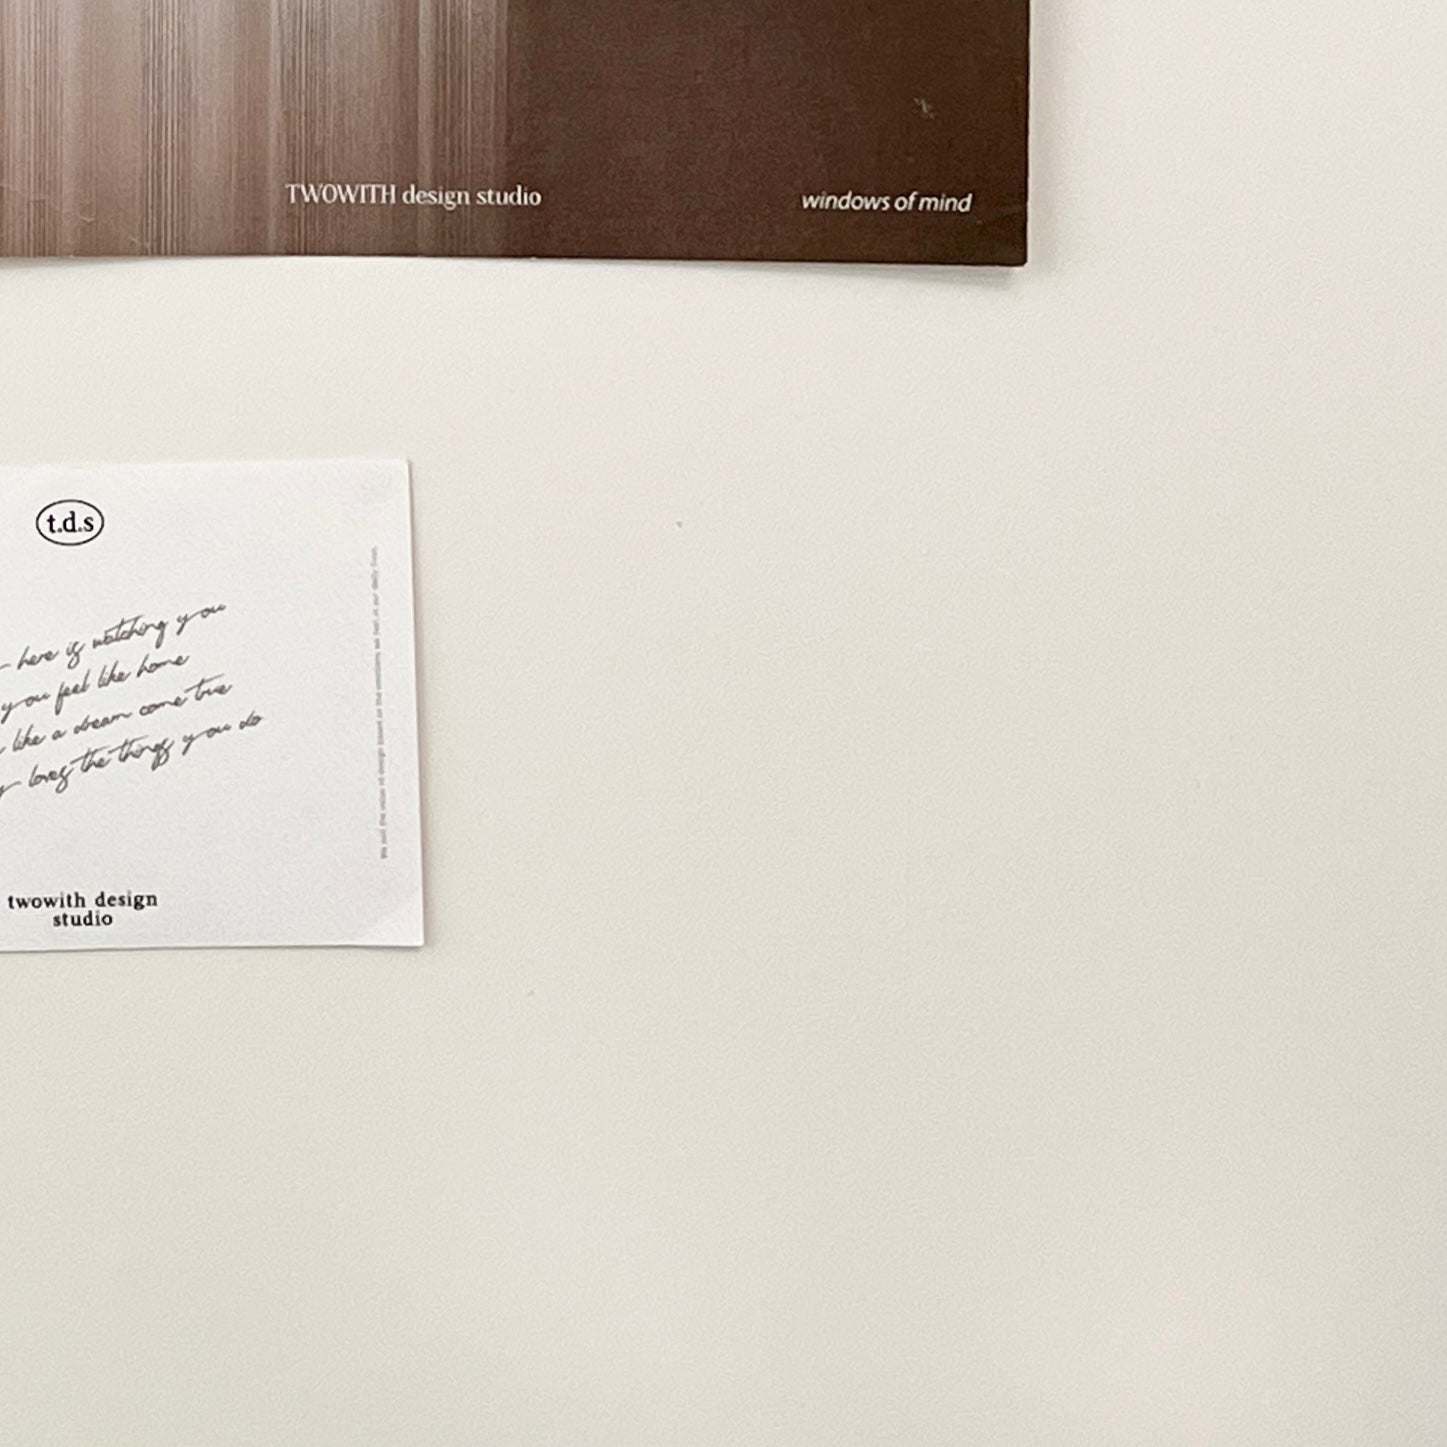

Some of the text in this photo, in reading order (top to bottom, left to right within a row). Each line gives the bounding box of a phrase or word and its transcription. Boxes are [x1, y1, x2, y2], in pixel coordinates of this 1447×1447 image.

[285, 183, 542, 211] TWOWITH design studio
[802, 190, 973, 213] windows of mind
[46, 510, 94, 533] t.d.s
[17, 645, 59, 670] here
[93, 614, 169, 649] watching
[177, 604, 226, 636] you
[1, 693, 50, 724] you
[55, 669, 90, 716] feel
[98, 660, 131, 688] like
[137, 653, 190, 677] home
[13, 724, 46, 752] like
[52, 729, 67, 740] a
[73, 715, 133, 734] dream
[139, 696, 188, 716] come
[184, 673, 233, 700] true
[70, 745, 111, 772] the
[182, 724, 231, 756] you
[239, 710, 263, 730] do
[8, 890, 158, 911] twowith design
[53, 910, 113, 927] studio
